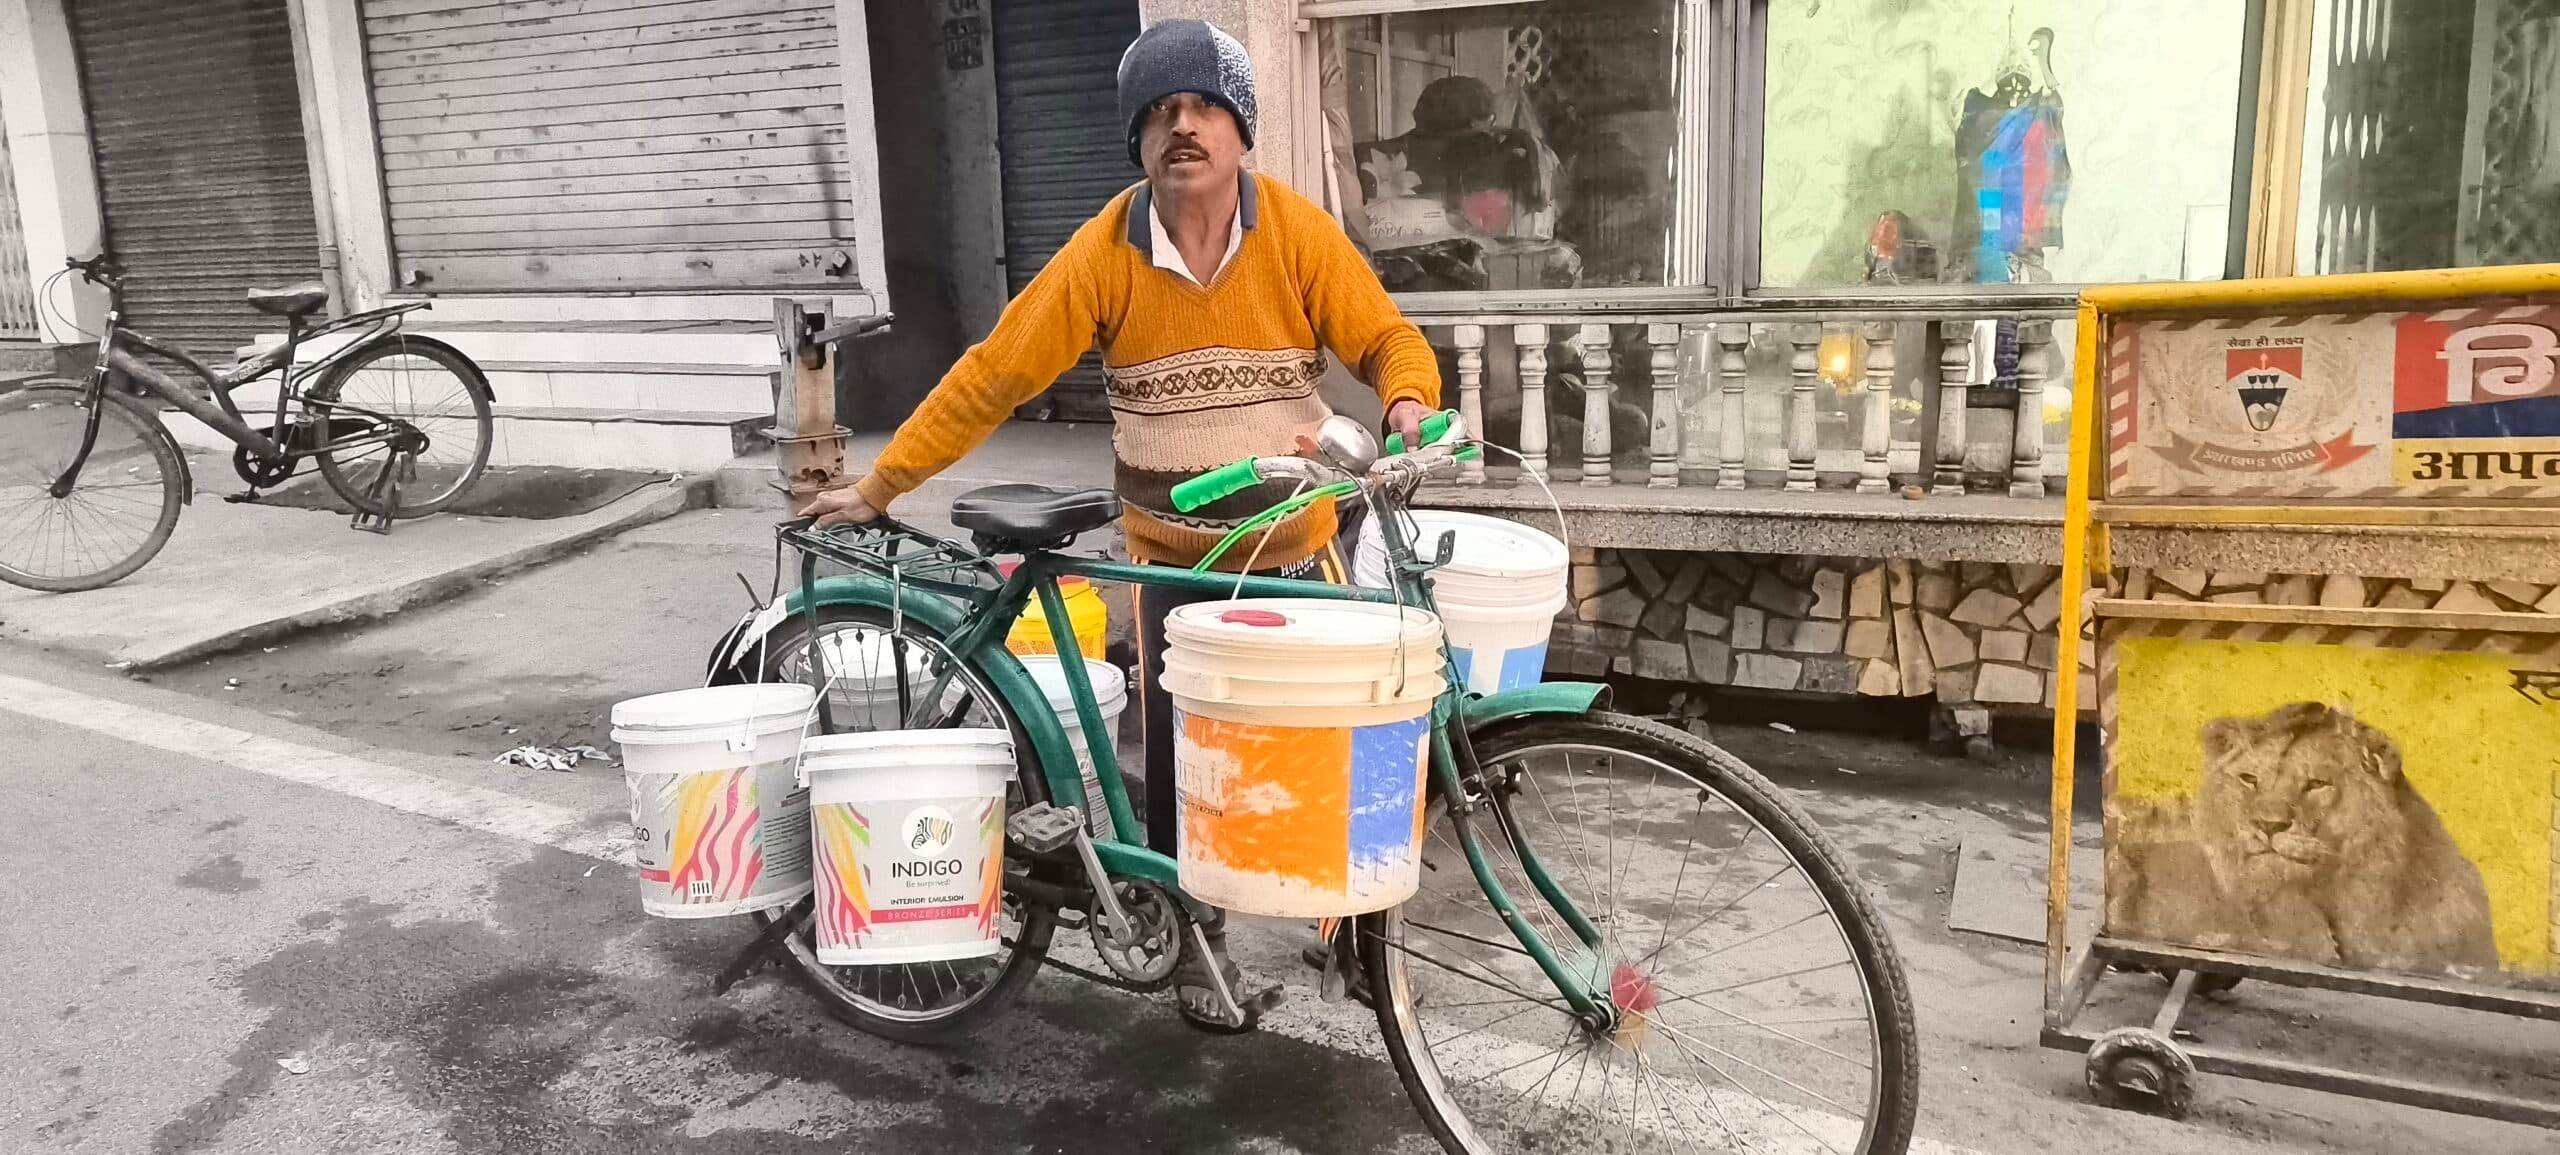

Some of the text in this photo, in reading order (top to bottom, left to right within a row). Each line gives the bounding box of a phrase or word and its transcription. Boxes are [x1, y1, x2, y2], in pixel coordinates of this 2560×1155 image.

[2226, 337, 2251, 347] सेवा
[2255, 335, 2269, 346] ही
[892, 859, 962, 878] INDIGO
[906, 880, 915, 888] Be
[890, 895, 964, 905] INTERIOR EMULSION
[887, 907, 967, 920] BRONZE SERIES
